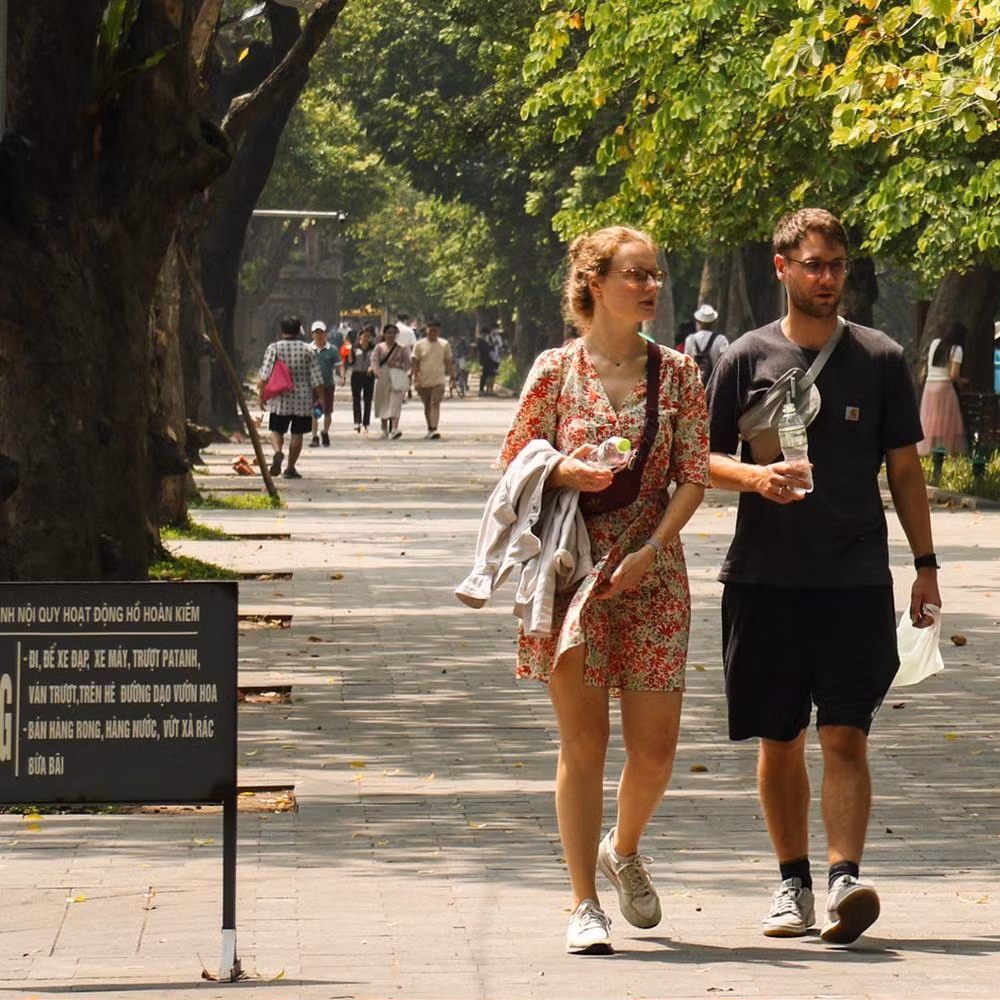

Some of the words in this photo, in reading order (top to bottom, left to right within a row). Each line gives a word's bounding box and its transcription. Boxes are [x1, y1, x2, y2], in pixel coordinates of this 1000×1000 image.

[17, 603, 36, 627] NỘI
[38, 606, 61, 623] QUY
[63, 606, 92, 627] HOẠT
[93, 602, 124, 627] ĐỘNG
[143, 602, 173, 622] HOÀN
[175, 601, 200, 622] KIẾM
[57, 649, 70, 669] XE
[94, 649, 106, 668] XE
[132, 648, 161, 672] TRƯỢT
[28, 681, 48, 704] VÁN
[173, 680, 198, 703] VƯỜN
[199, 684, 218, 702] HOA
[28, 715, 48, 740] BÁN
[49, 716, 75, 739] HÀNG
[105, 715, 131, 739] HÀNG
[163, 714, 180, 738] VỨT
[181, 712, 195, 738] XẢ
[196, 715, 215, 738] RÁC
